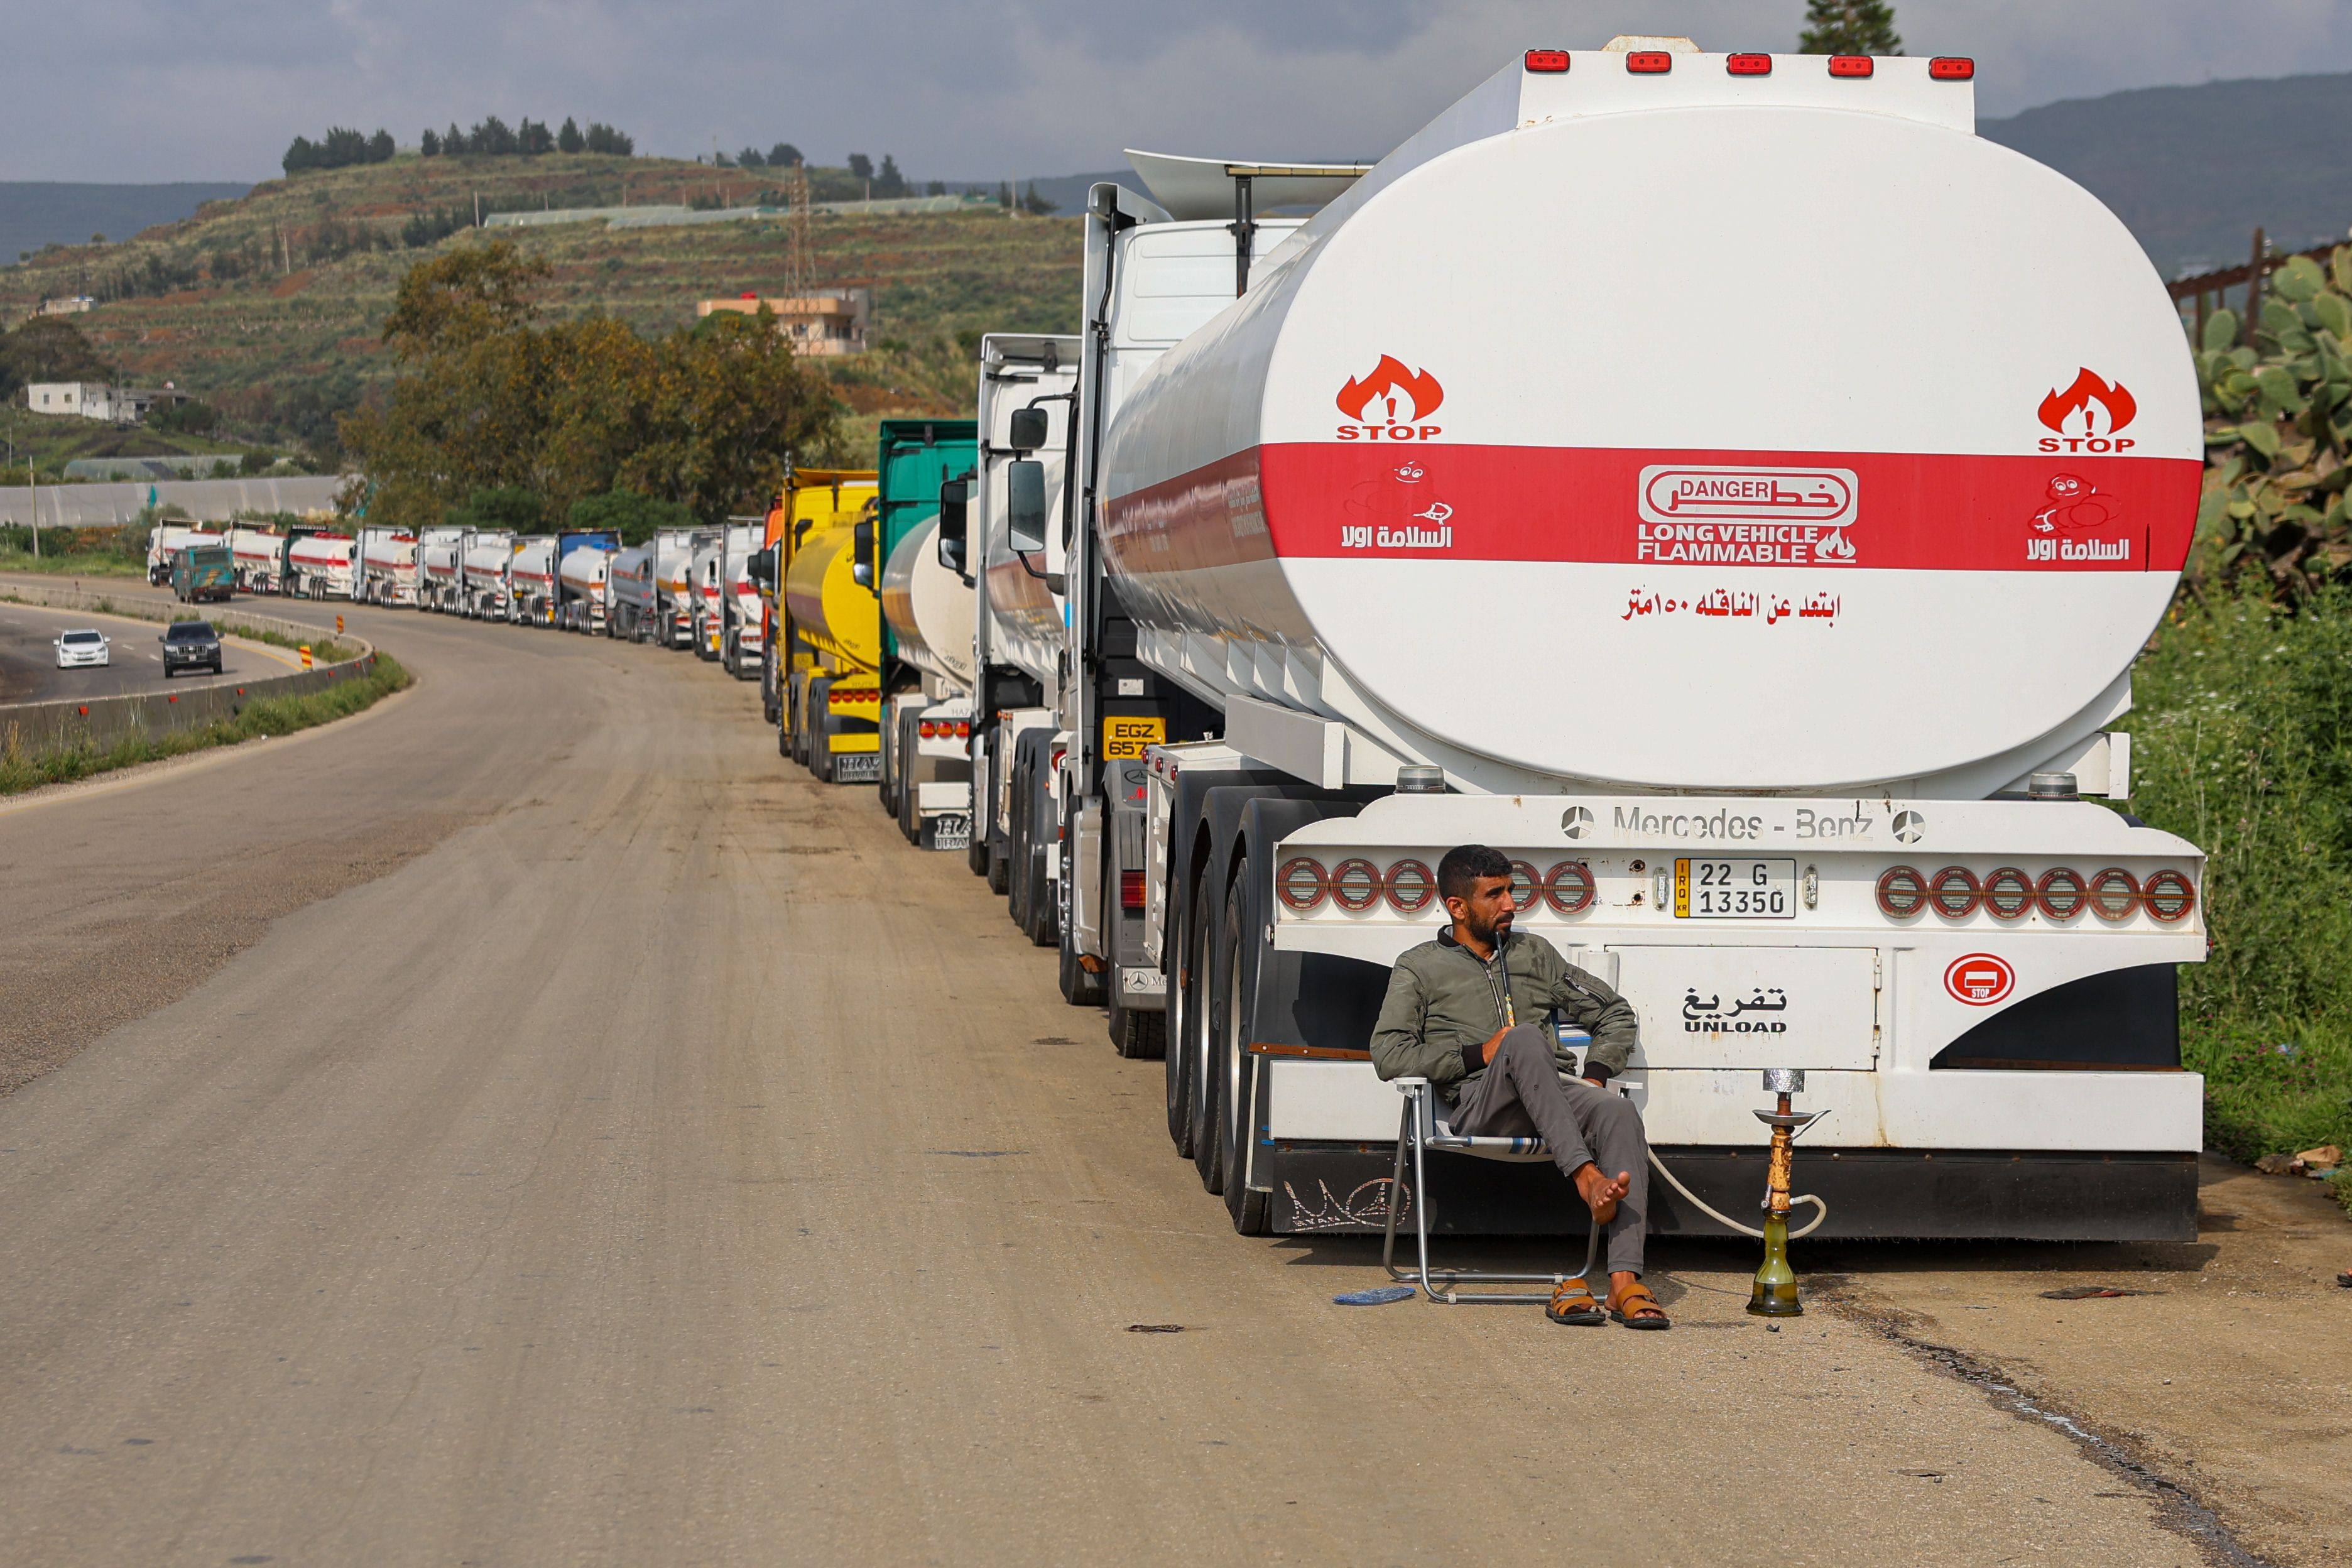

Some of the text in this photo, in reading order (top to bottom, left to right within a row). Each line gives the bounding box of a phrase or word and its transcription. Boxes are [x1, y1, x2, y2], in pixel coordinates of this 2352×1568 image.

[1336, 425, 1442, 440] STOP
[2038, 438, 2135, 453] STOP
[1668, 479, 1839, 511] خطر
[1680, 480, 1769, 498] DANGER
[1341, 525, 1452, 548] السلامة اولا
[1638, 524, 1819, 543] LONG VEHICLE
[1638, 542, 1808, 564] FLAMMABLE
[2027, 538, 2130, 560] السلامة اولا
[1695, 587, 1760, 617] الناقله
[1767, 593, 1792, 625] عن
[1799, 591, 1841, 628] ابتعد
[1115, 724, 1155, 738] EGZ
[1109, 741, 1159, 756] 657
[1613, 807, 1764, 840] Mercedes
[1796, 808, 1873, 841] Benz
[1700, 864, 1767, 886] 22 G
[1700, 891, 1784, 913] 13350
[1682, 987, 1787, 1020] تفريغ
[1971, 988, 1990, 998] STOP
[1684, 1021, 1787, 1033] UNLOAD
